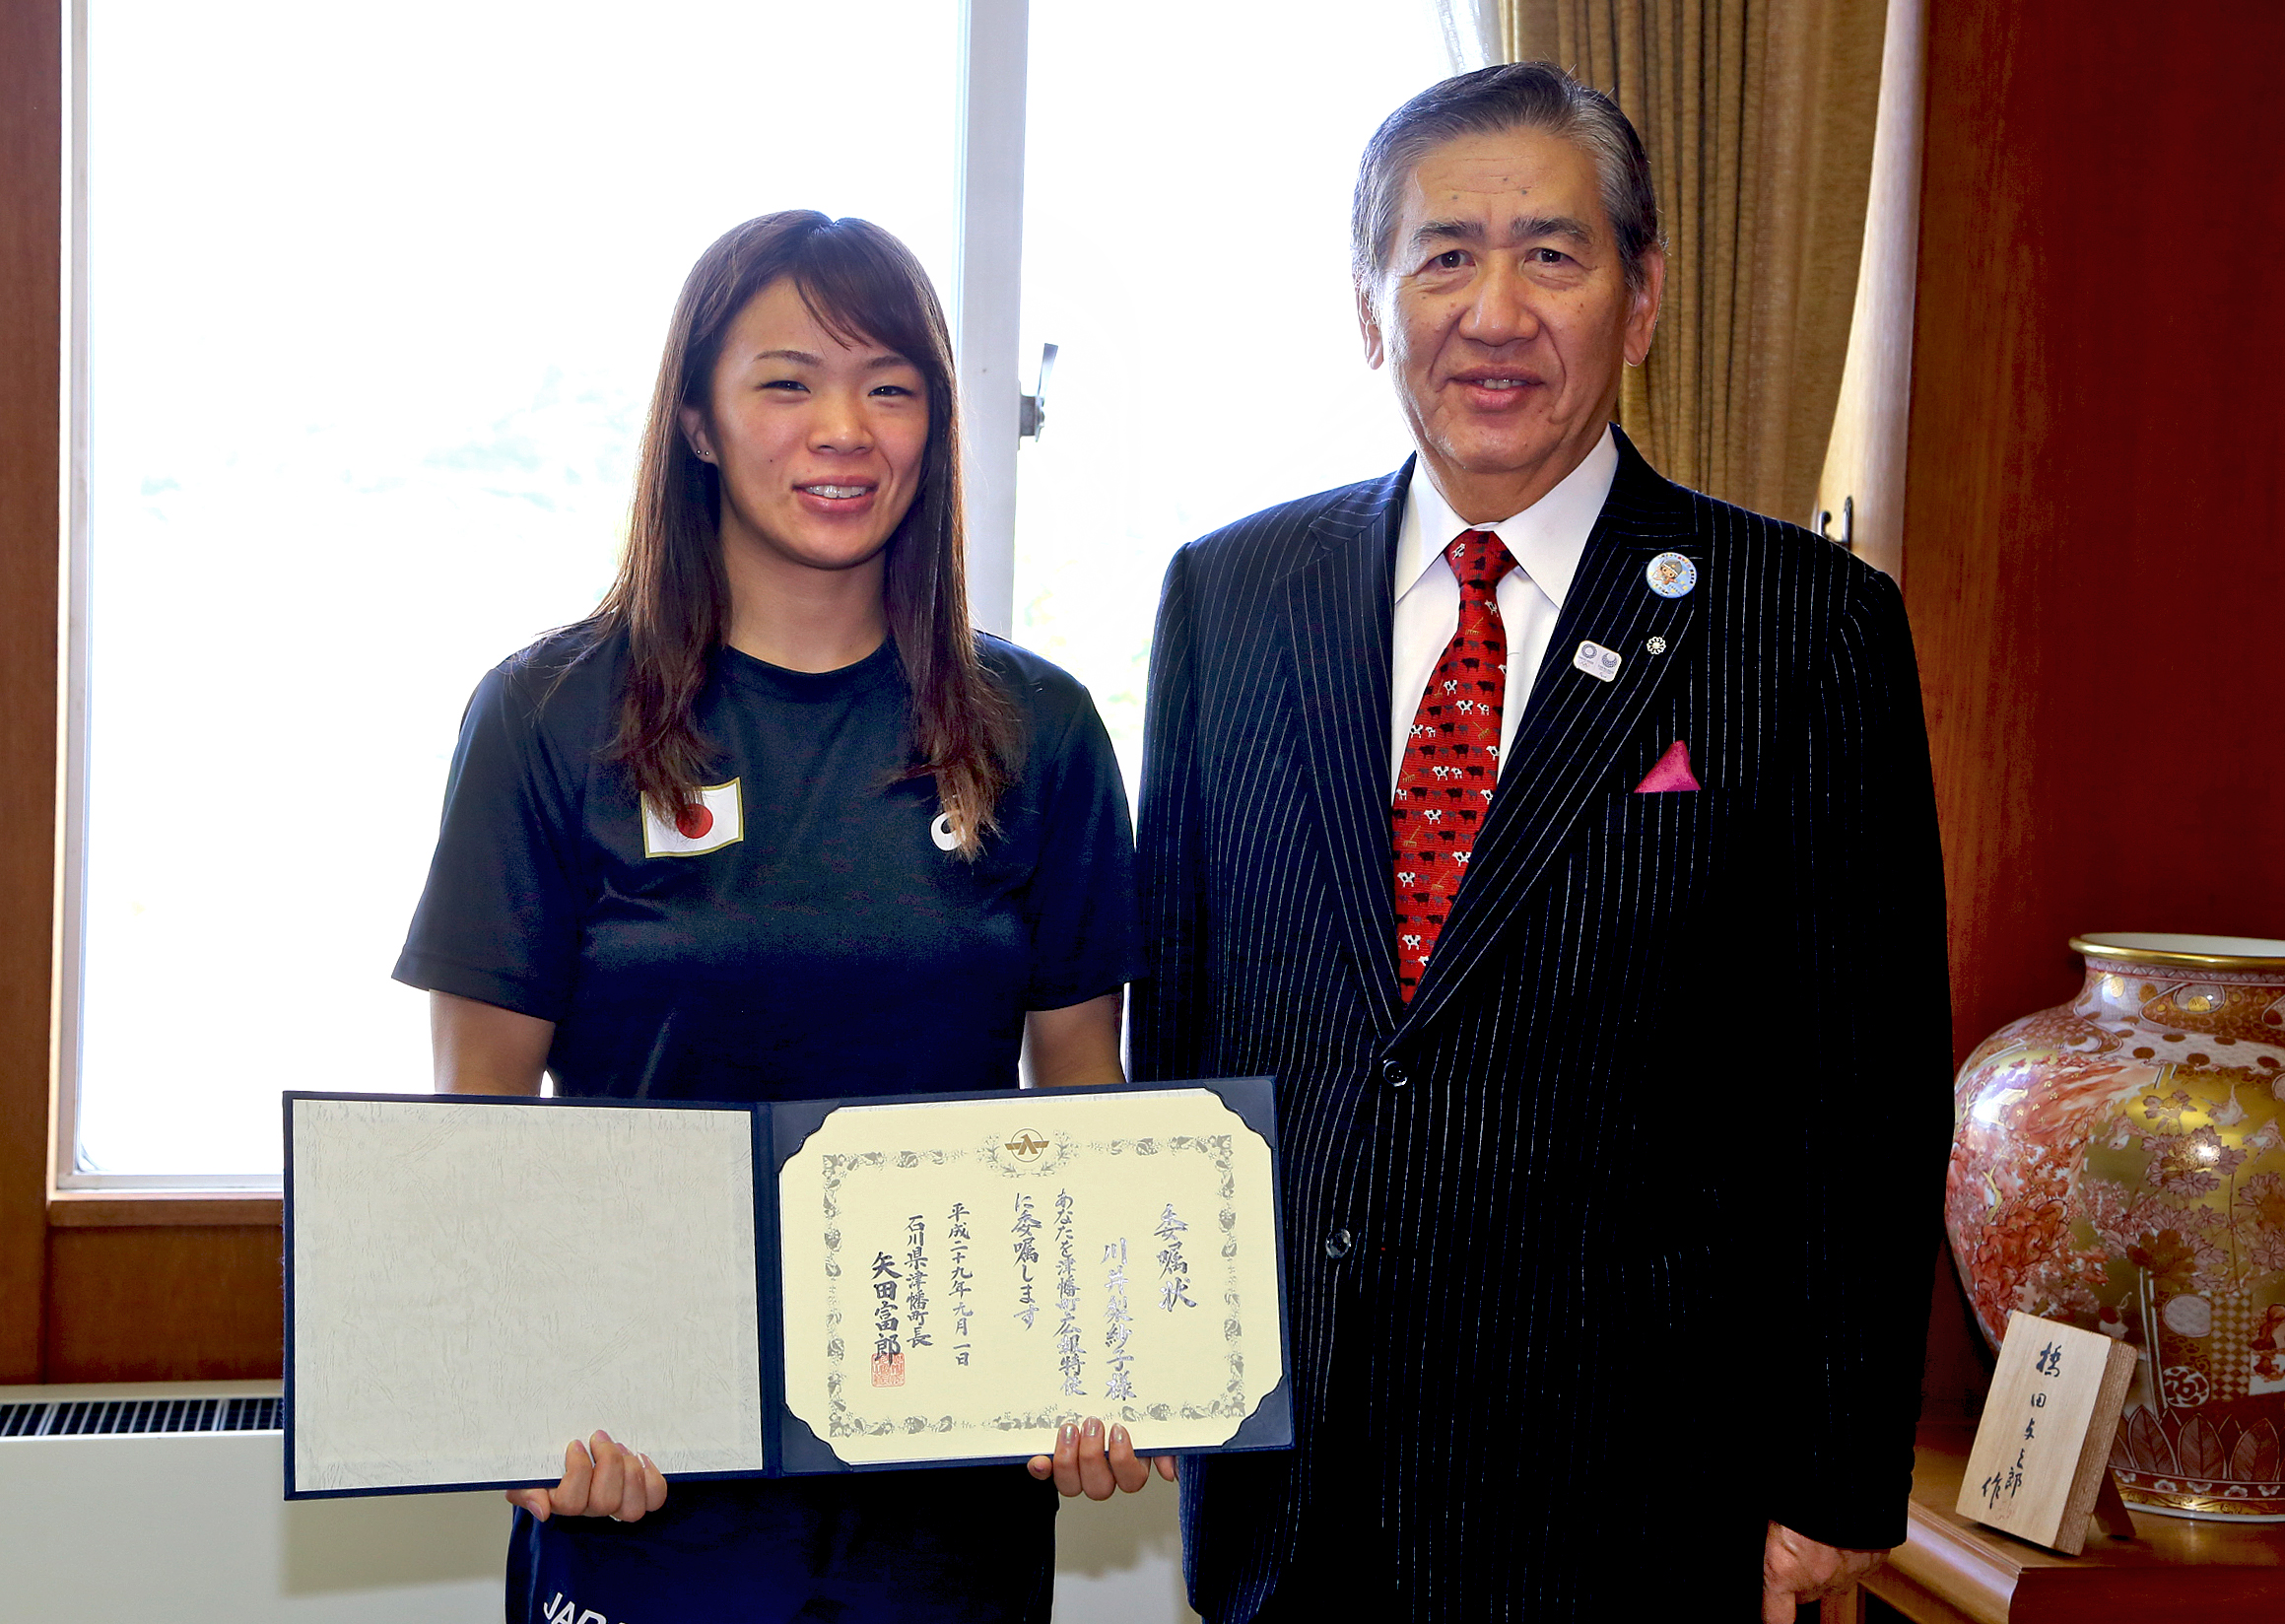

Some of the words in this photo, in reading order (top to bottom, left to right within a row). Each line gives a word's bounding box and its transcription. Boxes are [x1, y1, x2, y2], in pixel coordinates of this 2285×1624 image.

[871, 1251, 904, 1367] 矢田富郎
[904, 1214, 934, 1349] 石川県津幡町長
[947, 1202, 974, 1367] 平成二十九年九月一日
[1011, 1192, 1042, 1331] に委嘱します
[1053, 1187, 1088, 1396] あなたを津幡町広報特使
[1100, 1237, 1137, 1401] 川井梨紗子様
[1154, 1203, 1198, 1312] 委嘱状
